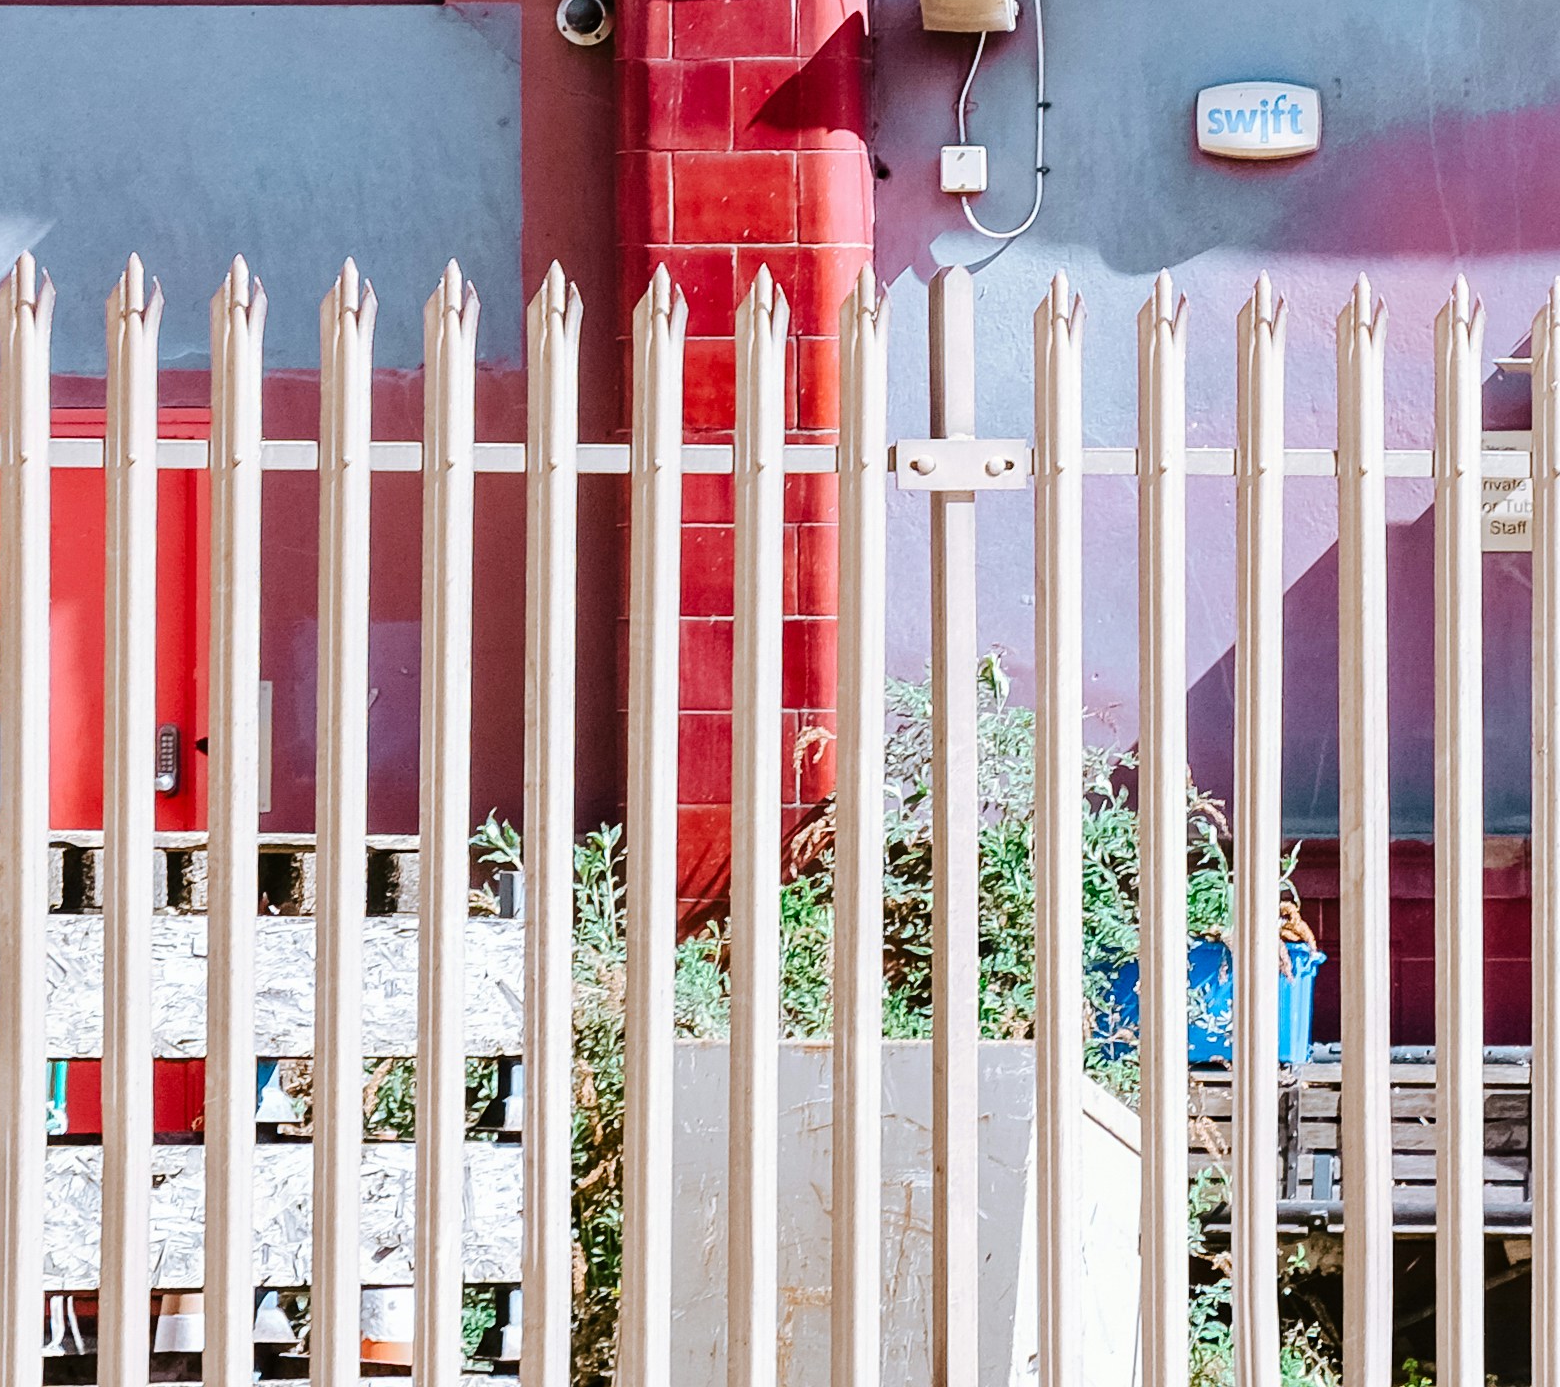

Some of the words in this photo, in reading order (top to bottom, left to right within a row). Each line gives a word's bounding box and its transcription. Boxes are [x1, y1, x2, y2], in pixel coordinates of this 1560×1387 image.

[1207, 94, 1304, 144] swift
[1482, 478, 1527, 492] rivate
[1505, 498, 1534, 514] Tub
[1489, 519, 1528, 535] Staff
